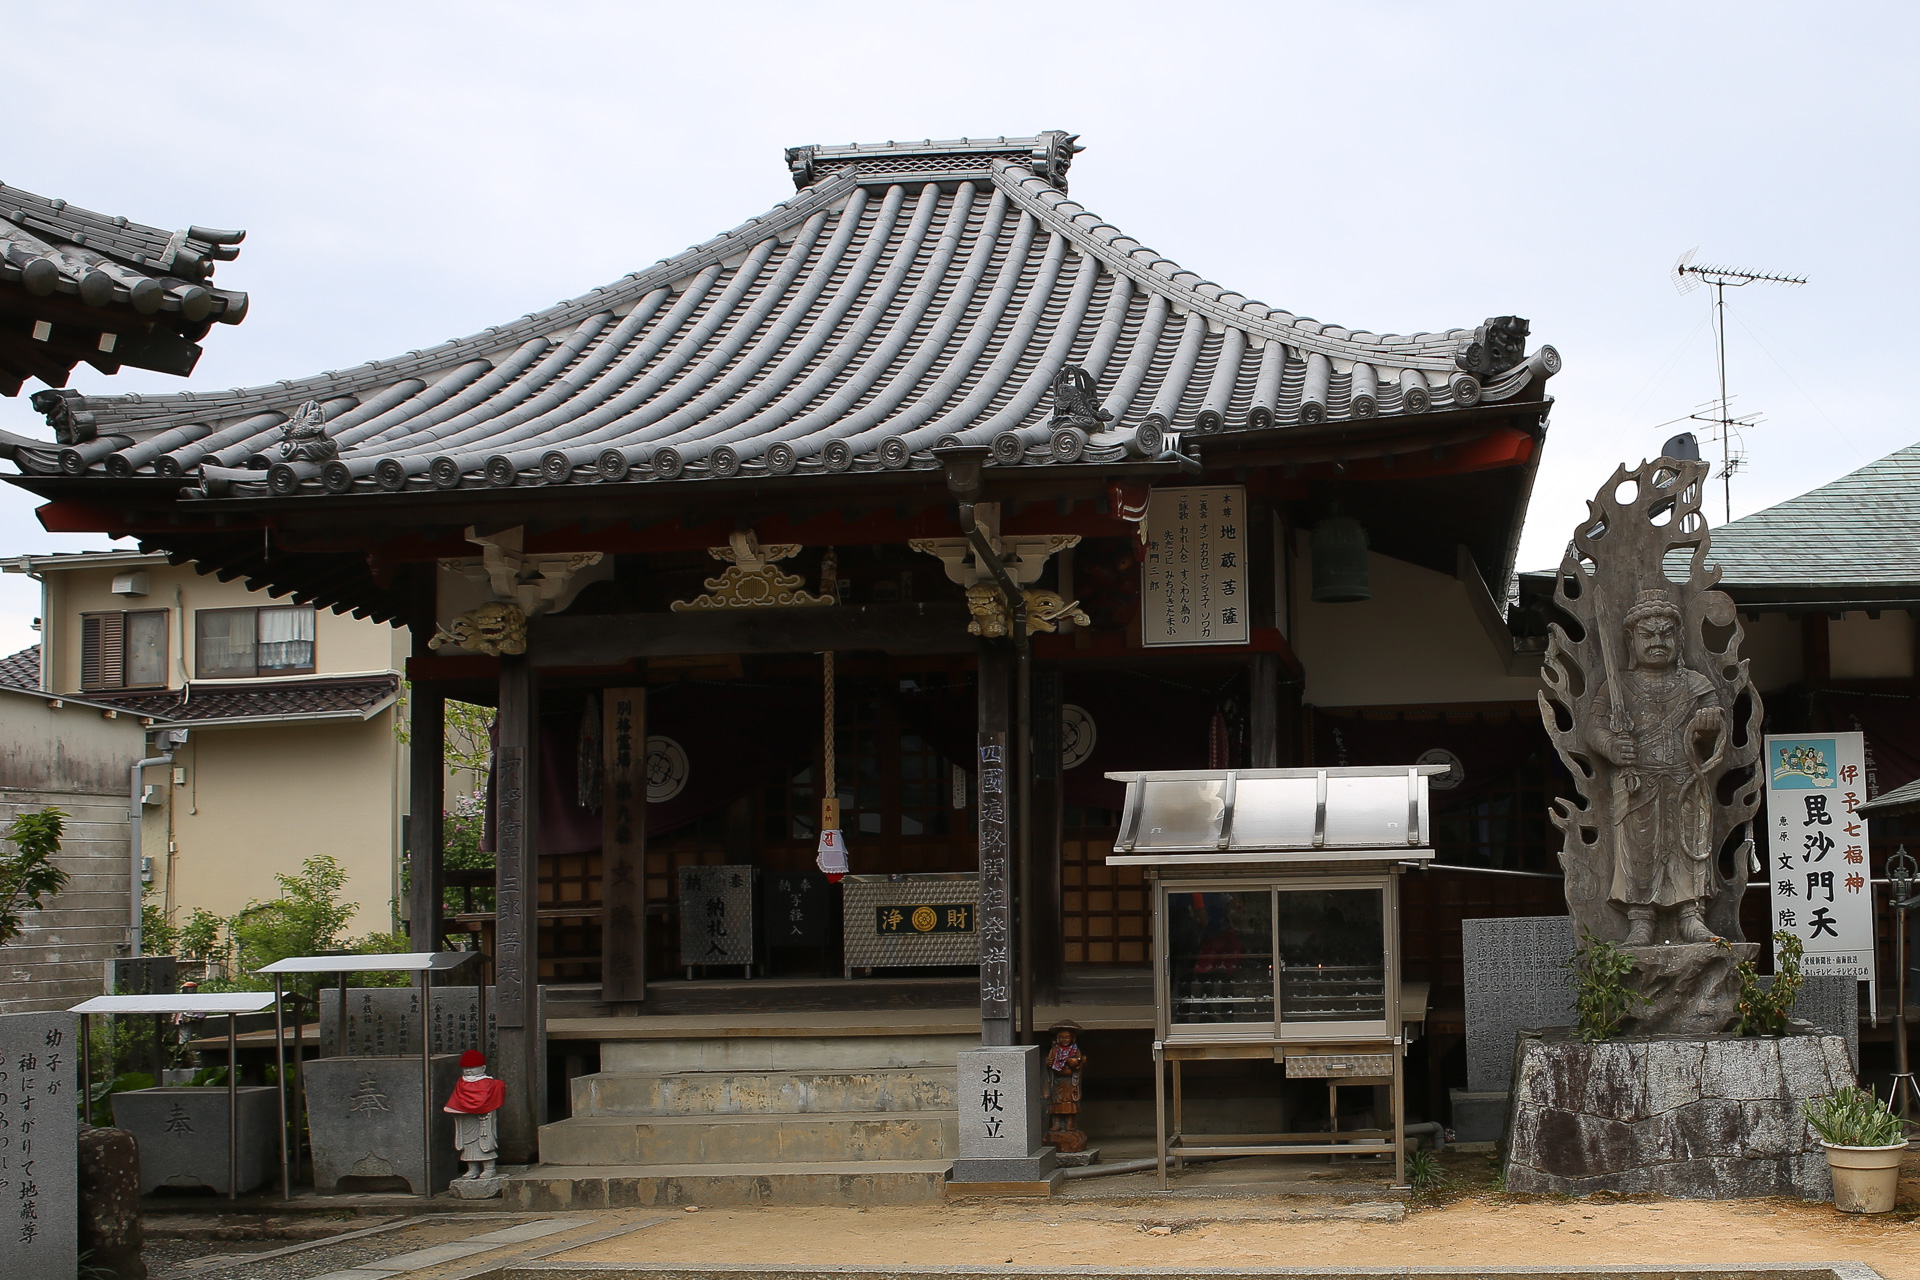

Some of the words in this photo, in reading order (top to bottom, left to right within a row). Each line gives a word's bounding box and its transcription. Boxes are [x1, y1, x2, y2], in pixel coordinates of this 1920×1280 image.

[1220, 524, 1239, 625] 地蔵菩薩
[1202, 612, 1211, 637] ソワカ
[1839, 764, 1865, 895] 伊予七福神
[1777, 852, 1799, 927] 文殊院
[1802, 794, 1838, 939] 毘沙門天
[704, 896, 729, 956] 納札入
[45, 1028, 62, 1095] 幼子が
[350, 1069, 391, 1119] 奉
[165, 1102, 195, 1142] 奉
[980, 1064, 1005, 1139] お杖立
